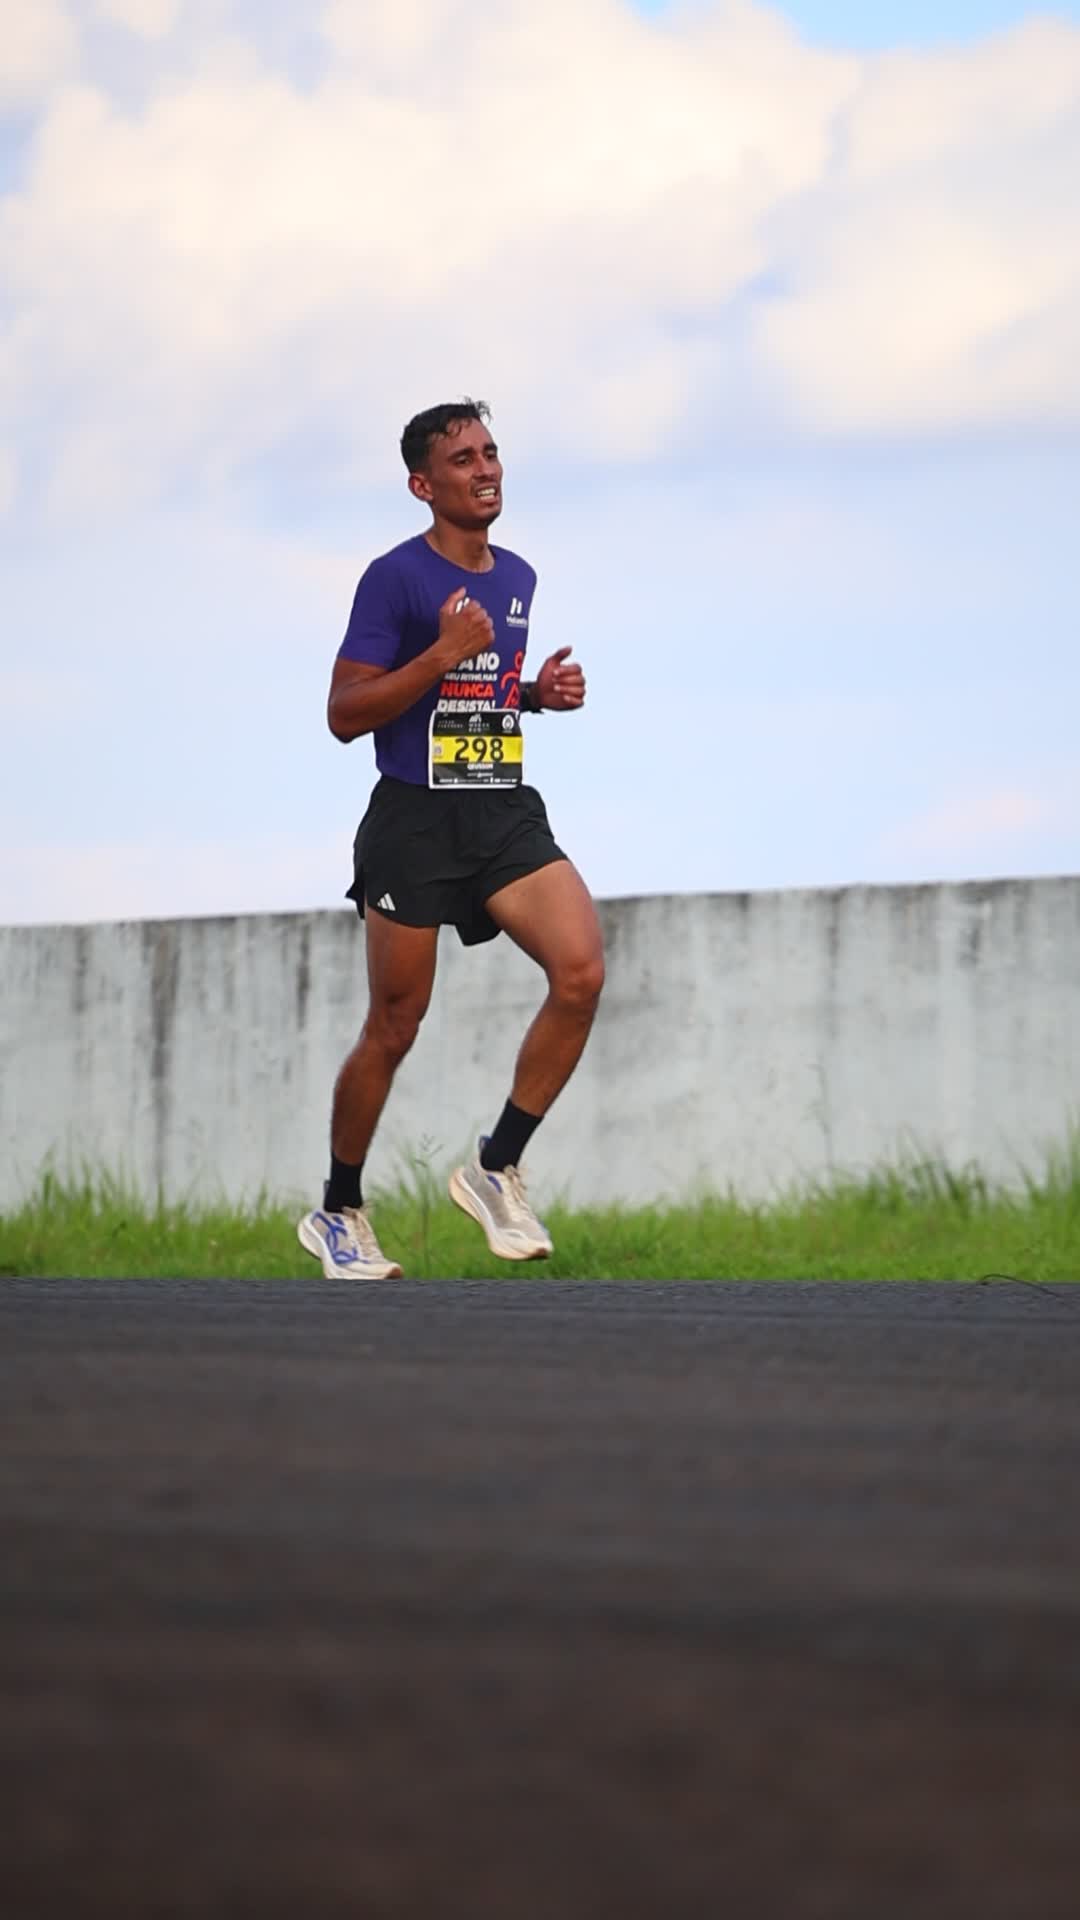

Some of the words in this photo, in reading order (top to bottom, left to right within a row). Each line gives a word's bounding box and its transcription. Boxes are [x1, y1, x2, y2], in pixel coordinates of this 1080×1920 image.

[475, 652, 500, 671] NO
[441, 683, 494, 697] NUNCA
[437, 699, 496, 712] DESISTA!
[454, 737, 504, 762] 298
